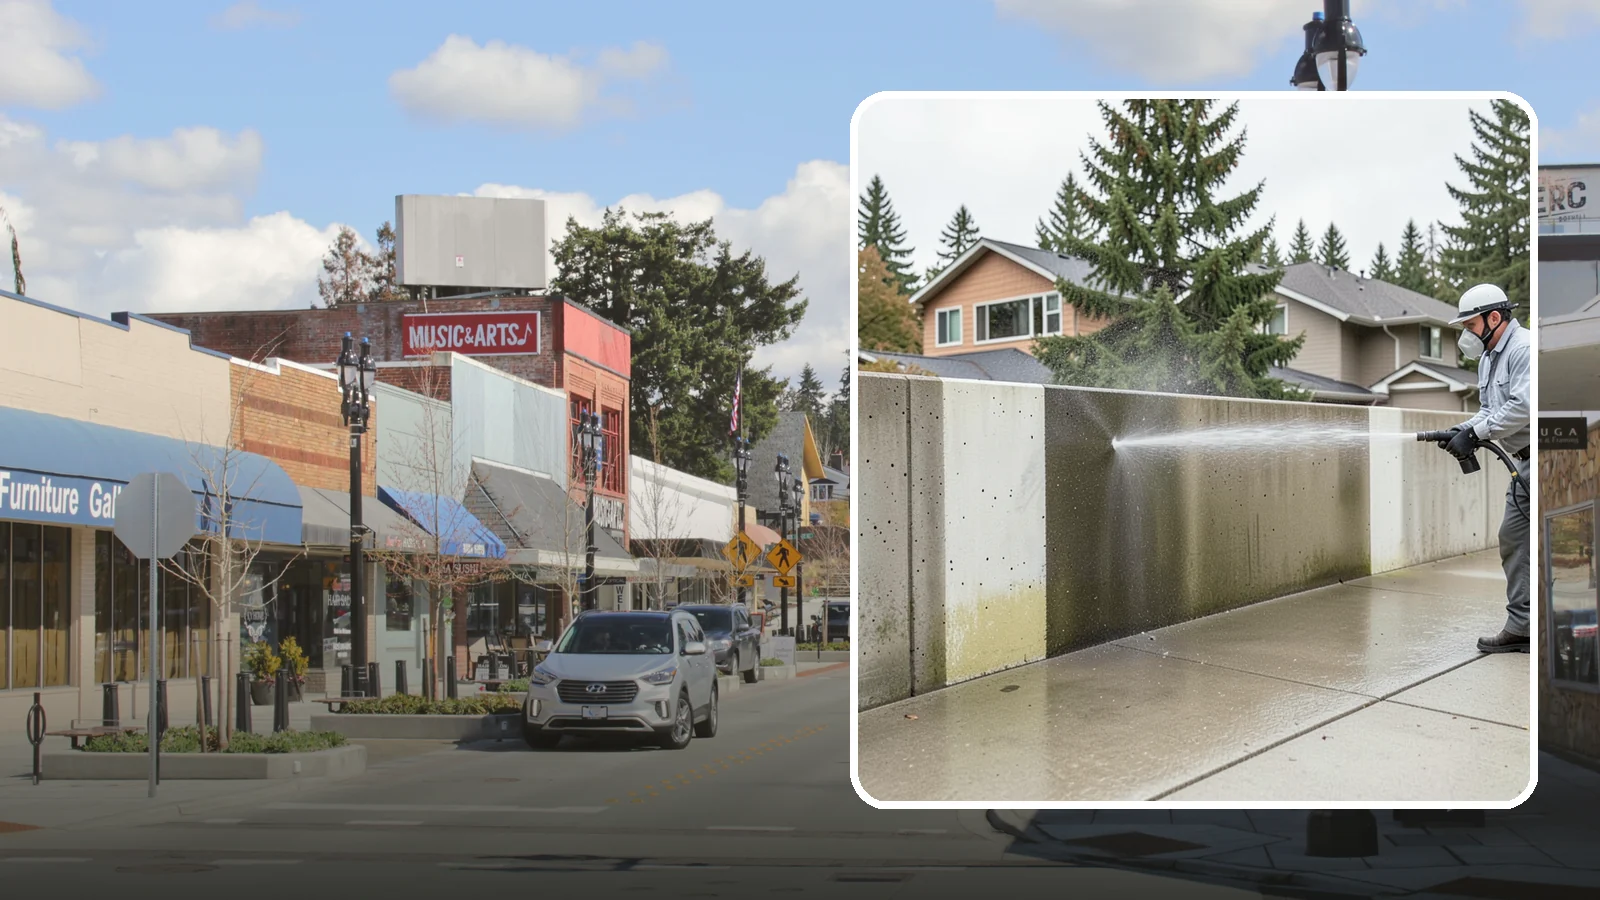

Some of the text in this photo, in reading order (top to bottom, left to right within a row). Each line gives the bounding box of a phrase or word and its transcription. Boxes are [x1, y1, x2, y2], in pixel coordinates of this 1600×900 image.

[0, 471, 122, 519] Furniture Gal
[453, 563, 479, 574] SUSHI
